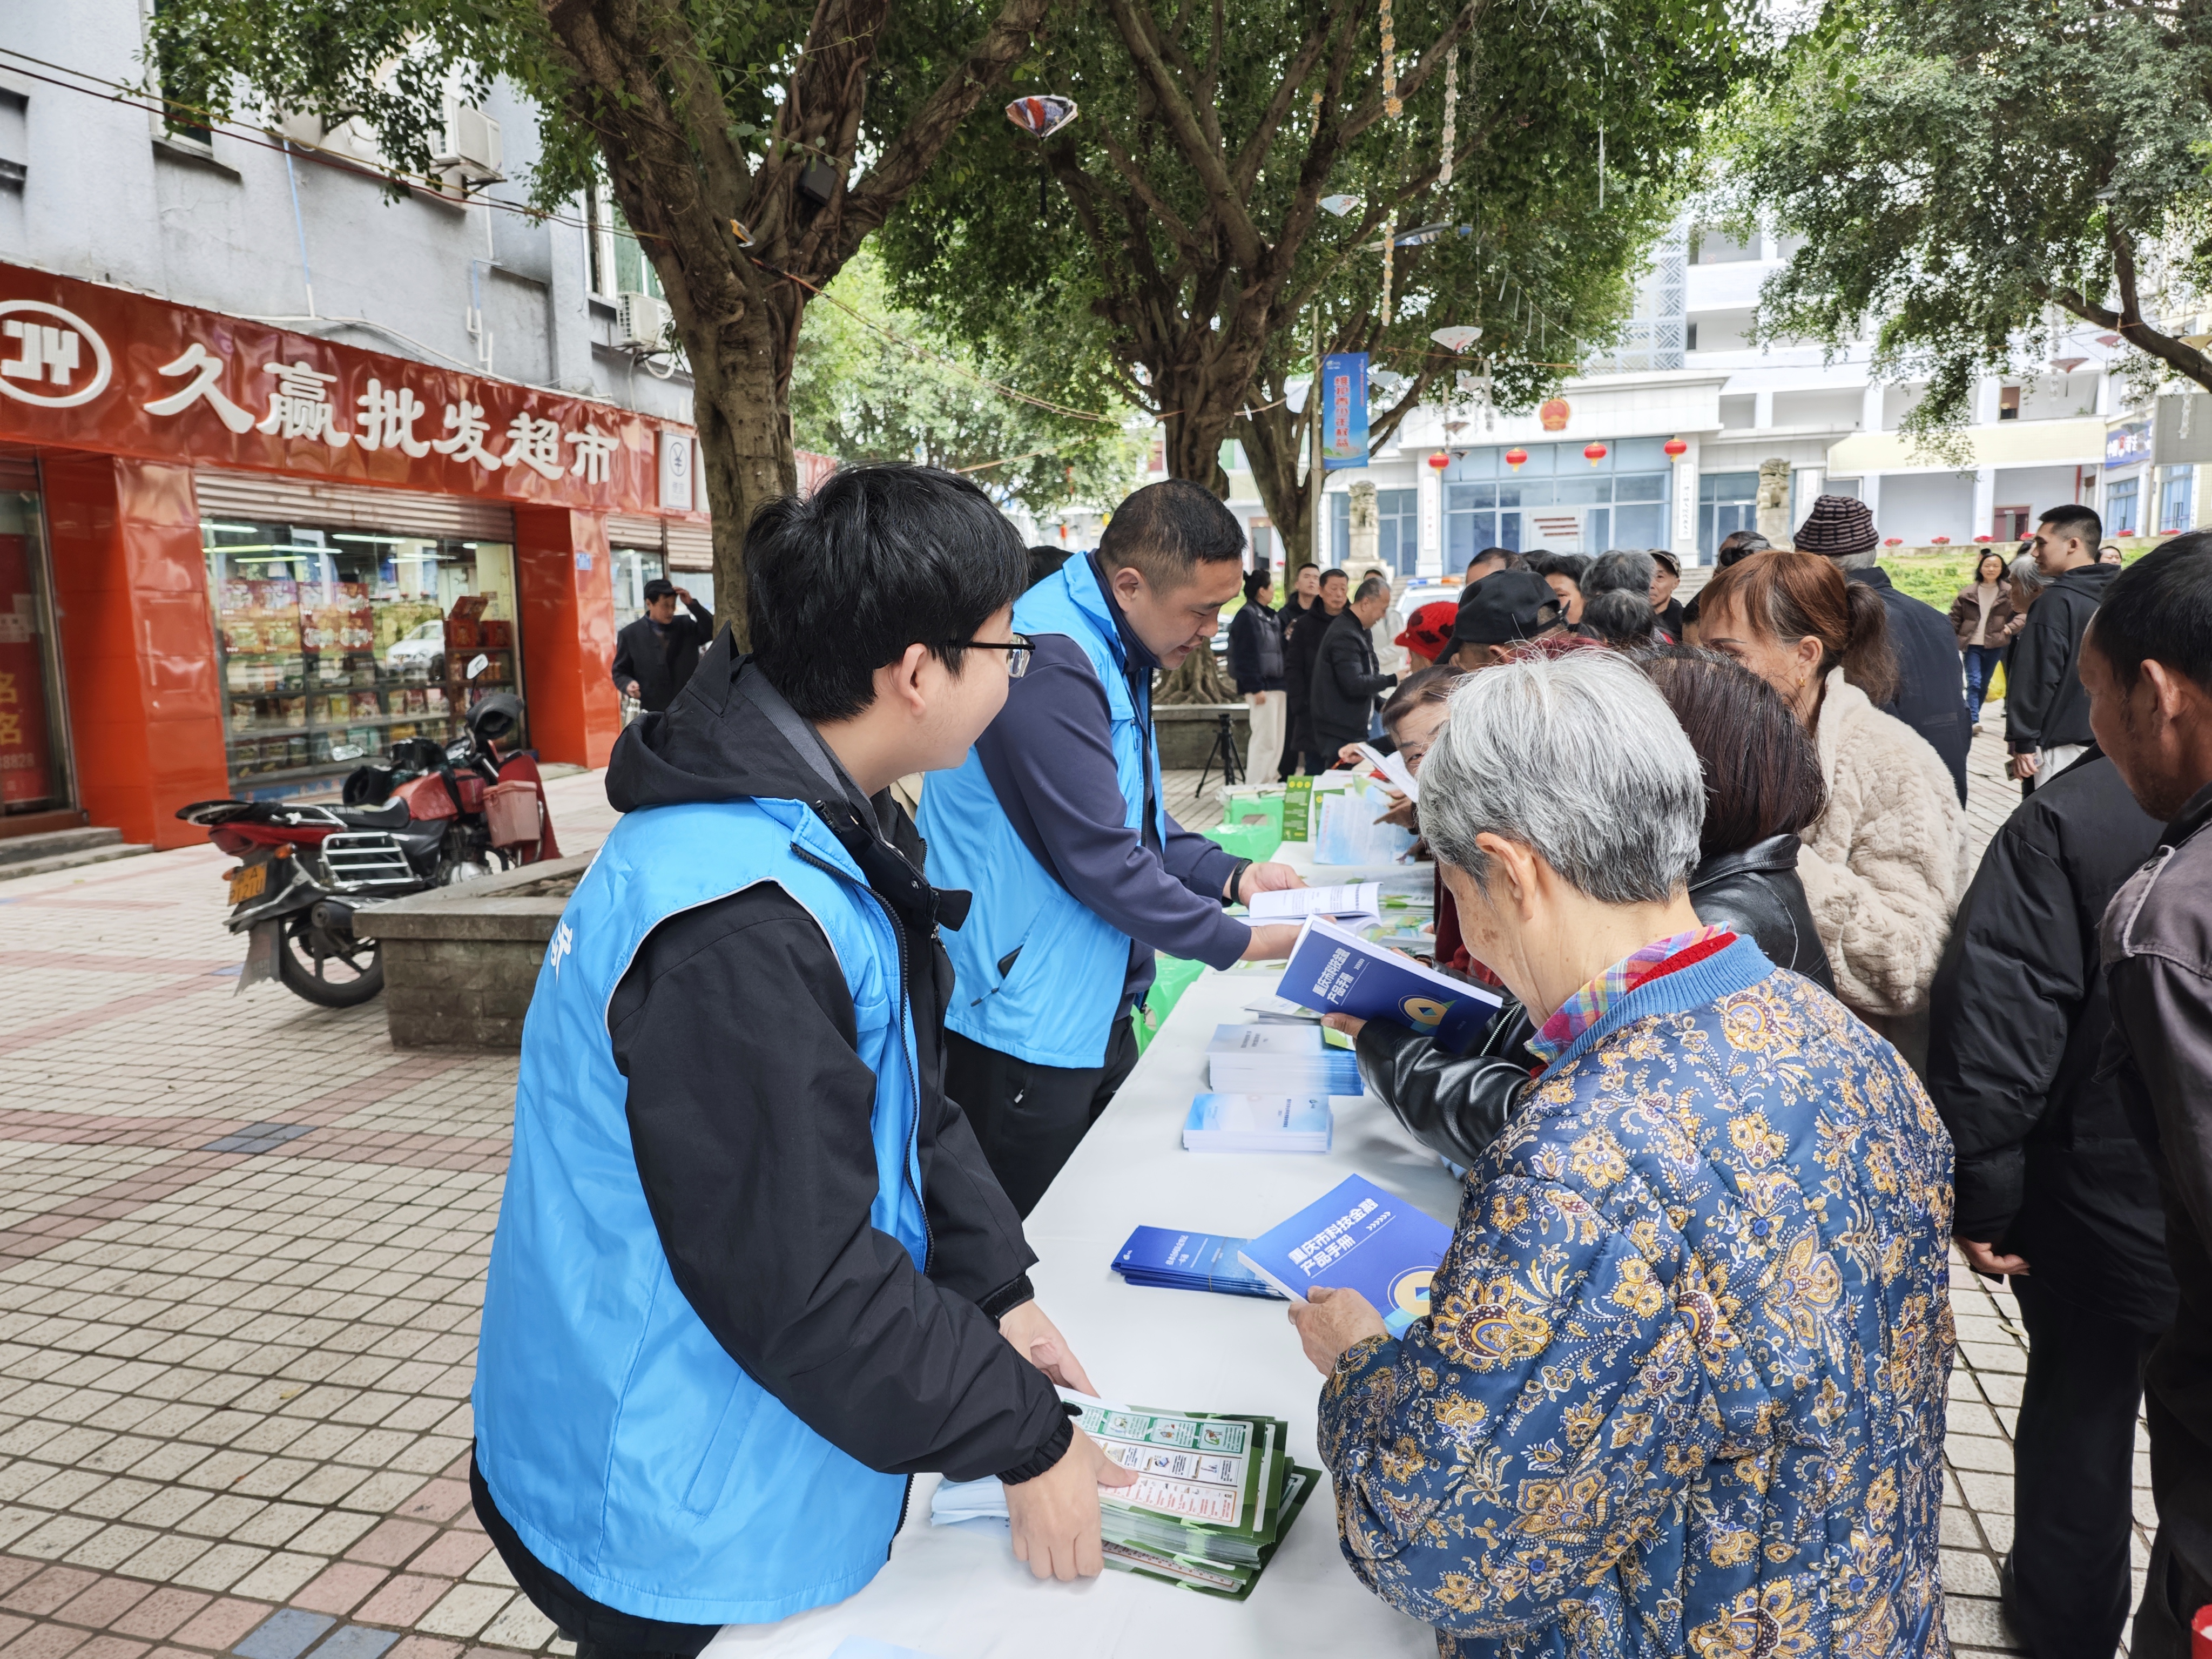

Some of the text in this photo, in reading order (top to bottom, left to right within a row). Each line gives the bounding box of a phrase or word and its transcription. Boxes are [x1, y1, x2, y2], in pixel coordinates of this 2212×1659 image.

[143, 342, 620, 485] 久赢批发超市
[1334, 376, 1350, 447] 维护青少年权益
[1312, 947, 1351, 997] 重庆市科技金融
[1327, 972, 1354, 1005] 产品手册
[1288, 1197, 1379, 1266] 重庆市科技金融
[1299, 1233, 1356, 1277] 产品手册
